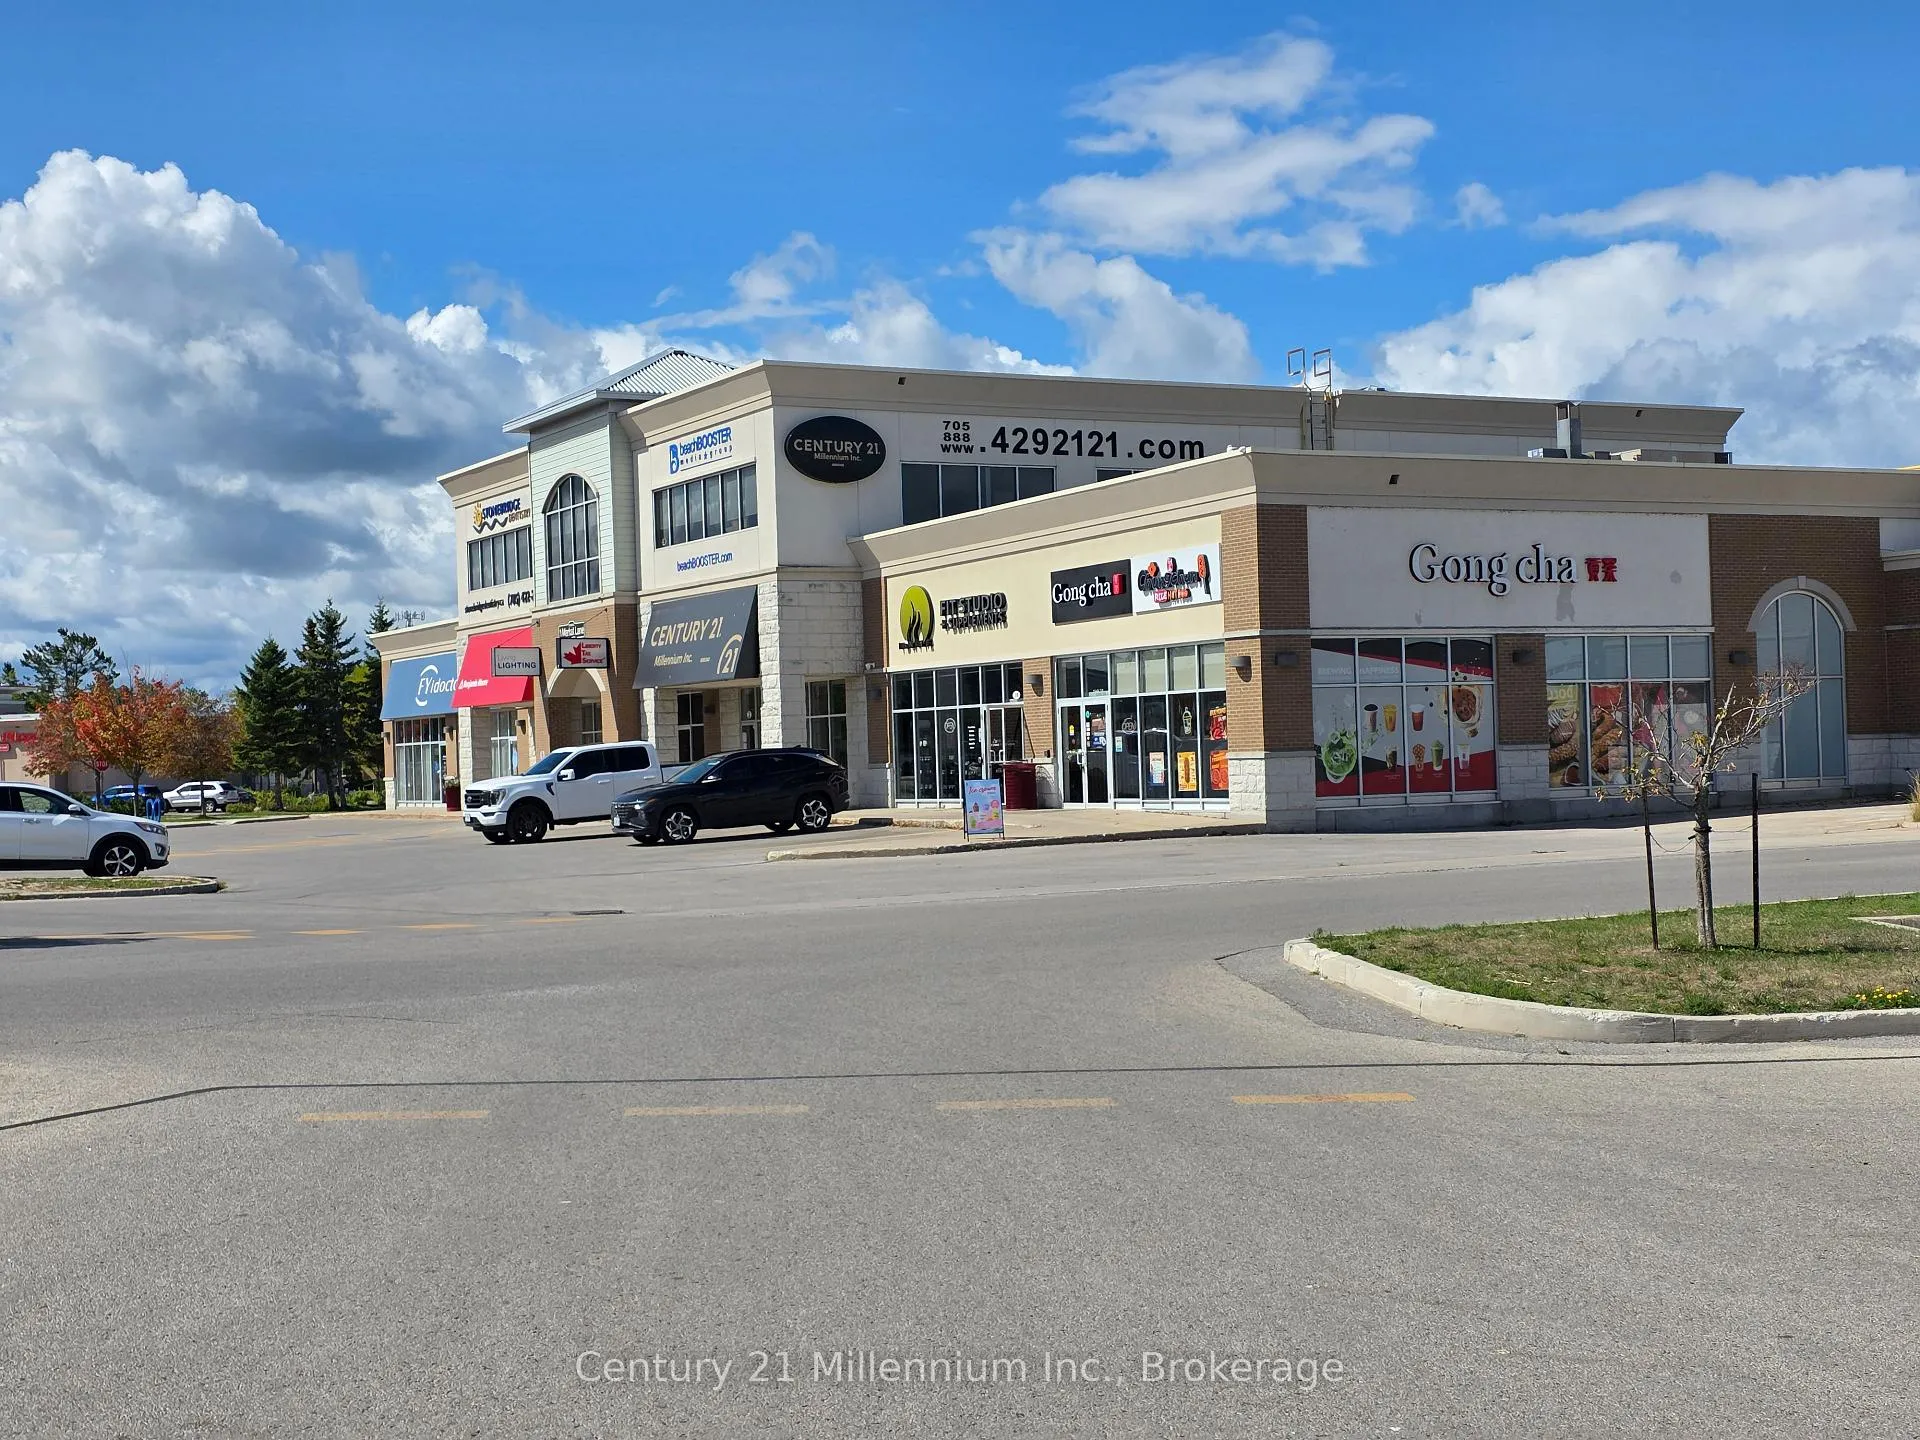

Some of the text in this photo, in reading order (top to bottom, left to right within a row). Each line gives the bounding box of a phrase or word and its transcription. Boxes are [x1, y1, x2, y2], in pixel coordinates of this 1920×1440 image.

[942, 420, 970, 431] 705
[679, 427, 732, 456] beachBOOSTER
[793, 438, 863, 454] CENTURY
[943, 432, 970, 442] 888
[814, 452, 849, 462] Millennium
[940, 443, 974, 454] www
[676, 552, 733, 572] beachBOOSTER.com
[1408, 542, 1578, 597] Gong cha
[1052, 583, 1086, 607] Gong
[1088, 576, 1112, 600] cha
[940, 593, 1004, 617] FIT STUDIO
[946, 611, 1004, 630] SUPPLEMENTS
[651, 619, 709, 647] CENTURY
[497, 661, 537, 670] LIGHTING
[721, 646, 739, 674] 21
